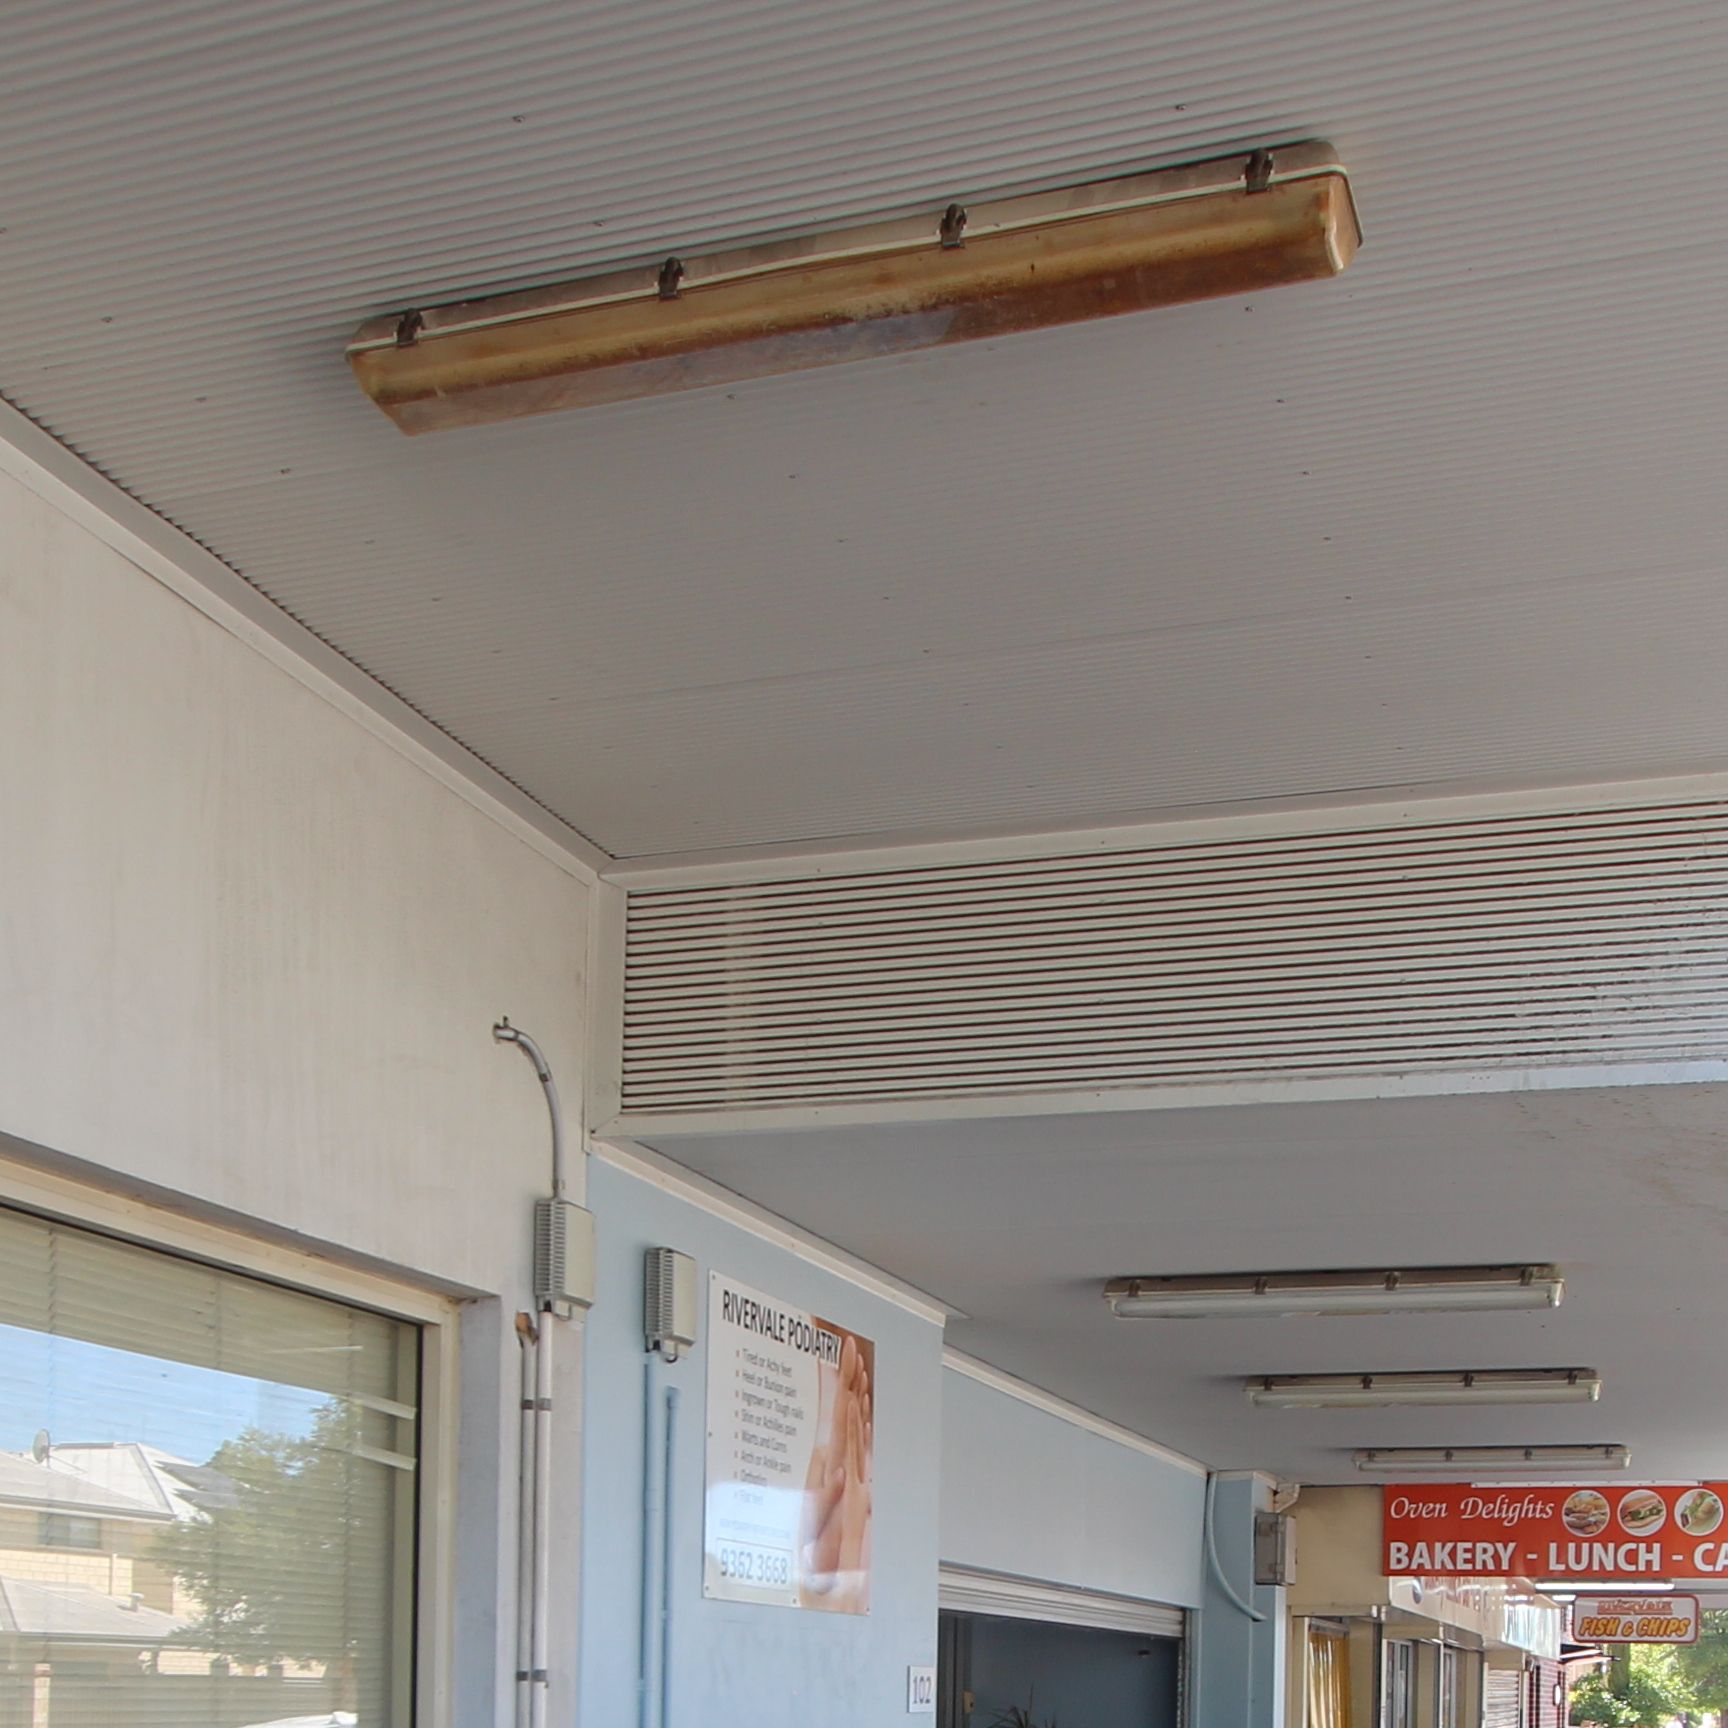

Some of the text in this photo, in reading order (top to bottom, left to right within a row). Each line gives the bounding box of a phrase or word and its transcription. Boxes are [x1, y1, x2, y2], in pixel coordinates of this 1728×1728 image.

[723, 1289, 840, 1364] RIVERVALE PODIATRY
[1390, 1494, 1555, 1527] Oven Delights
[720, 1548, 787, 1584] 9362 3668
[1389, 1542, 1516, 1570] BAKERY
[1548, 1542, 1661, 1572] LUNCH
[1579, 1617, 1617, 1637] FISH
[1636, 1617, 1690, 1637] CHIPS
[913, 1675, 931, 1704] 102
